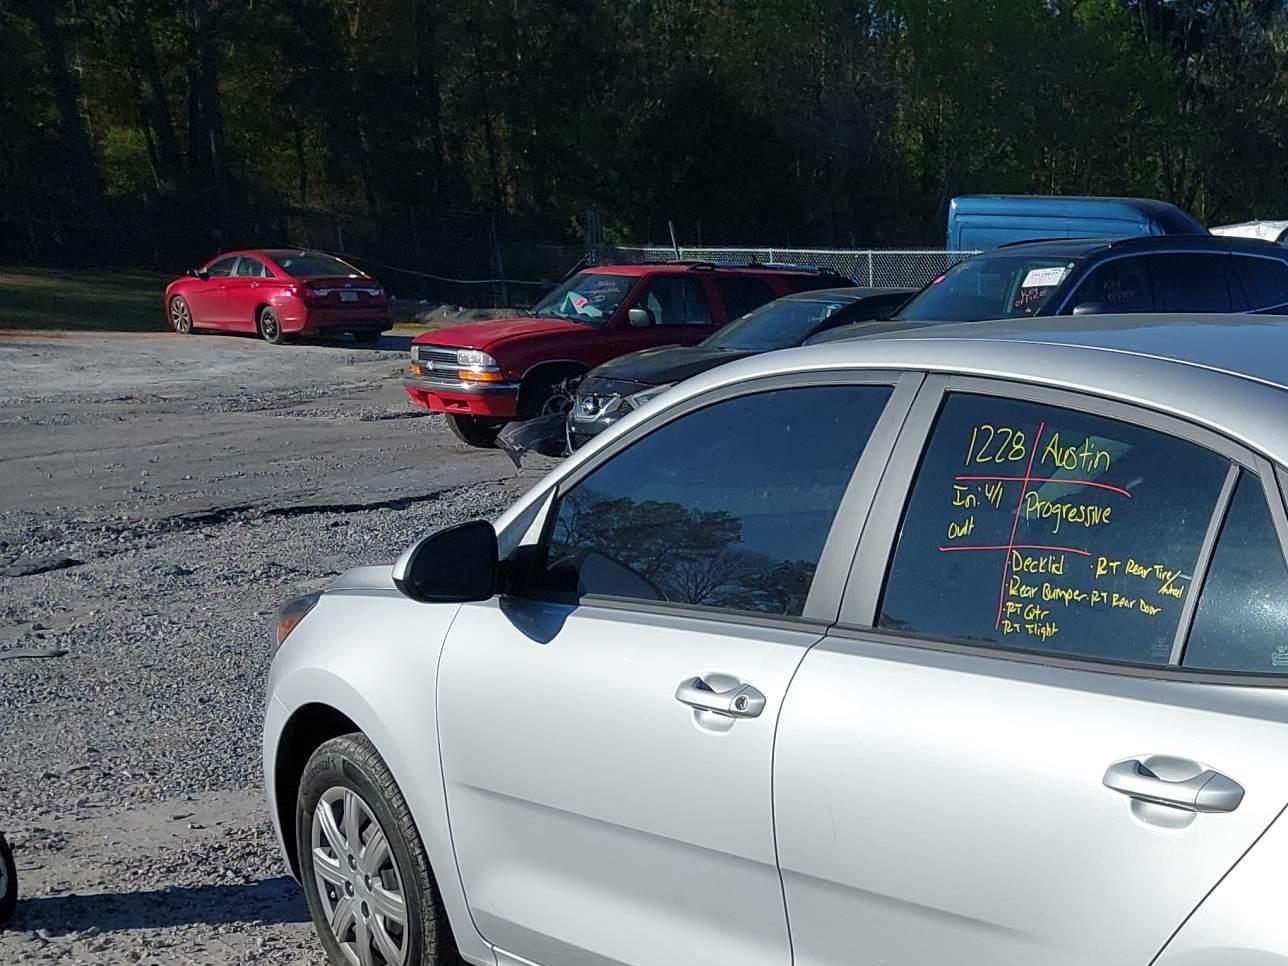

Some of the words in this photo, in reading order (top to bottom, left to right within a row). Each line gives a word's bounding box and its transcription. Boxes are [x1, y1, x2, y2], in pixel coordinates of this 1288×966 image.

[965, 424, 1026, 467] 1228
[1041, 431, 1111, 473] Austin
[1024, 490, 1112, 534] Progressive
[1095, 556, 1121, 579] RT
[1125, 558, 1152, 579] Rear
[1009, 575, 1038, 599] Rear
[1042, 582, 1088, 608] Bumper
[1090, 590, 1108, 608] RT
[1111, 593, 1137, 609] Rear
[1139, 598, 1162, 616] Door
